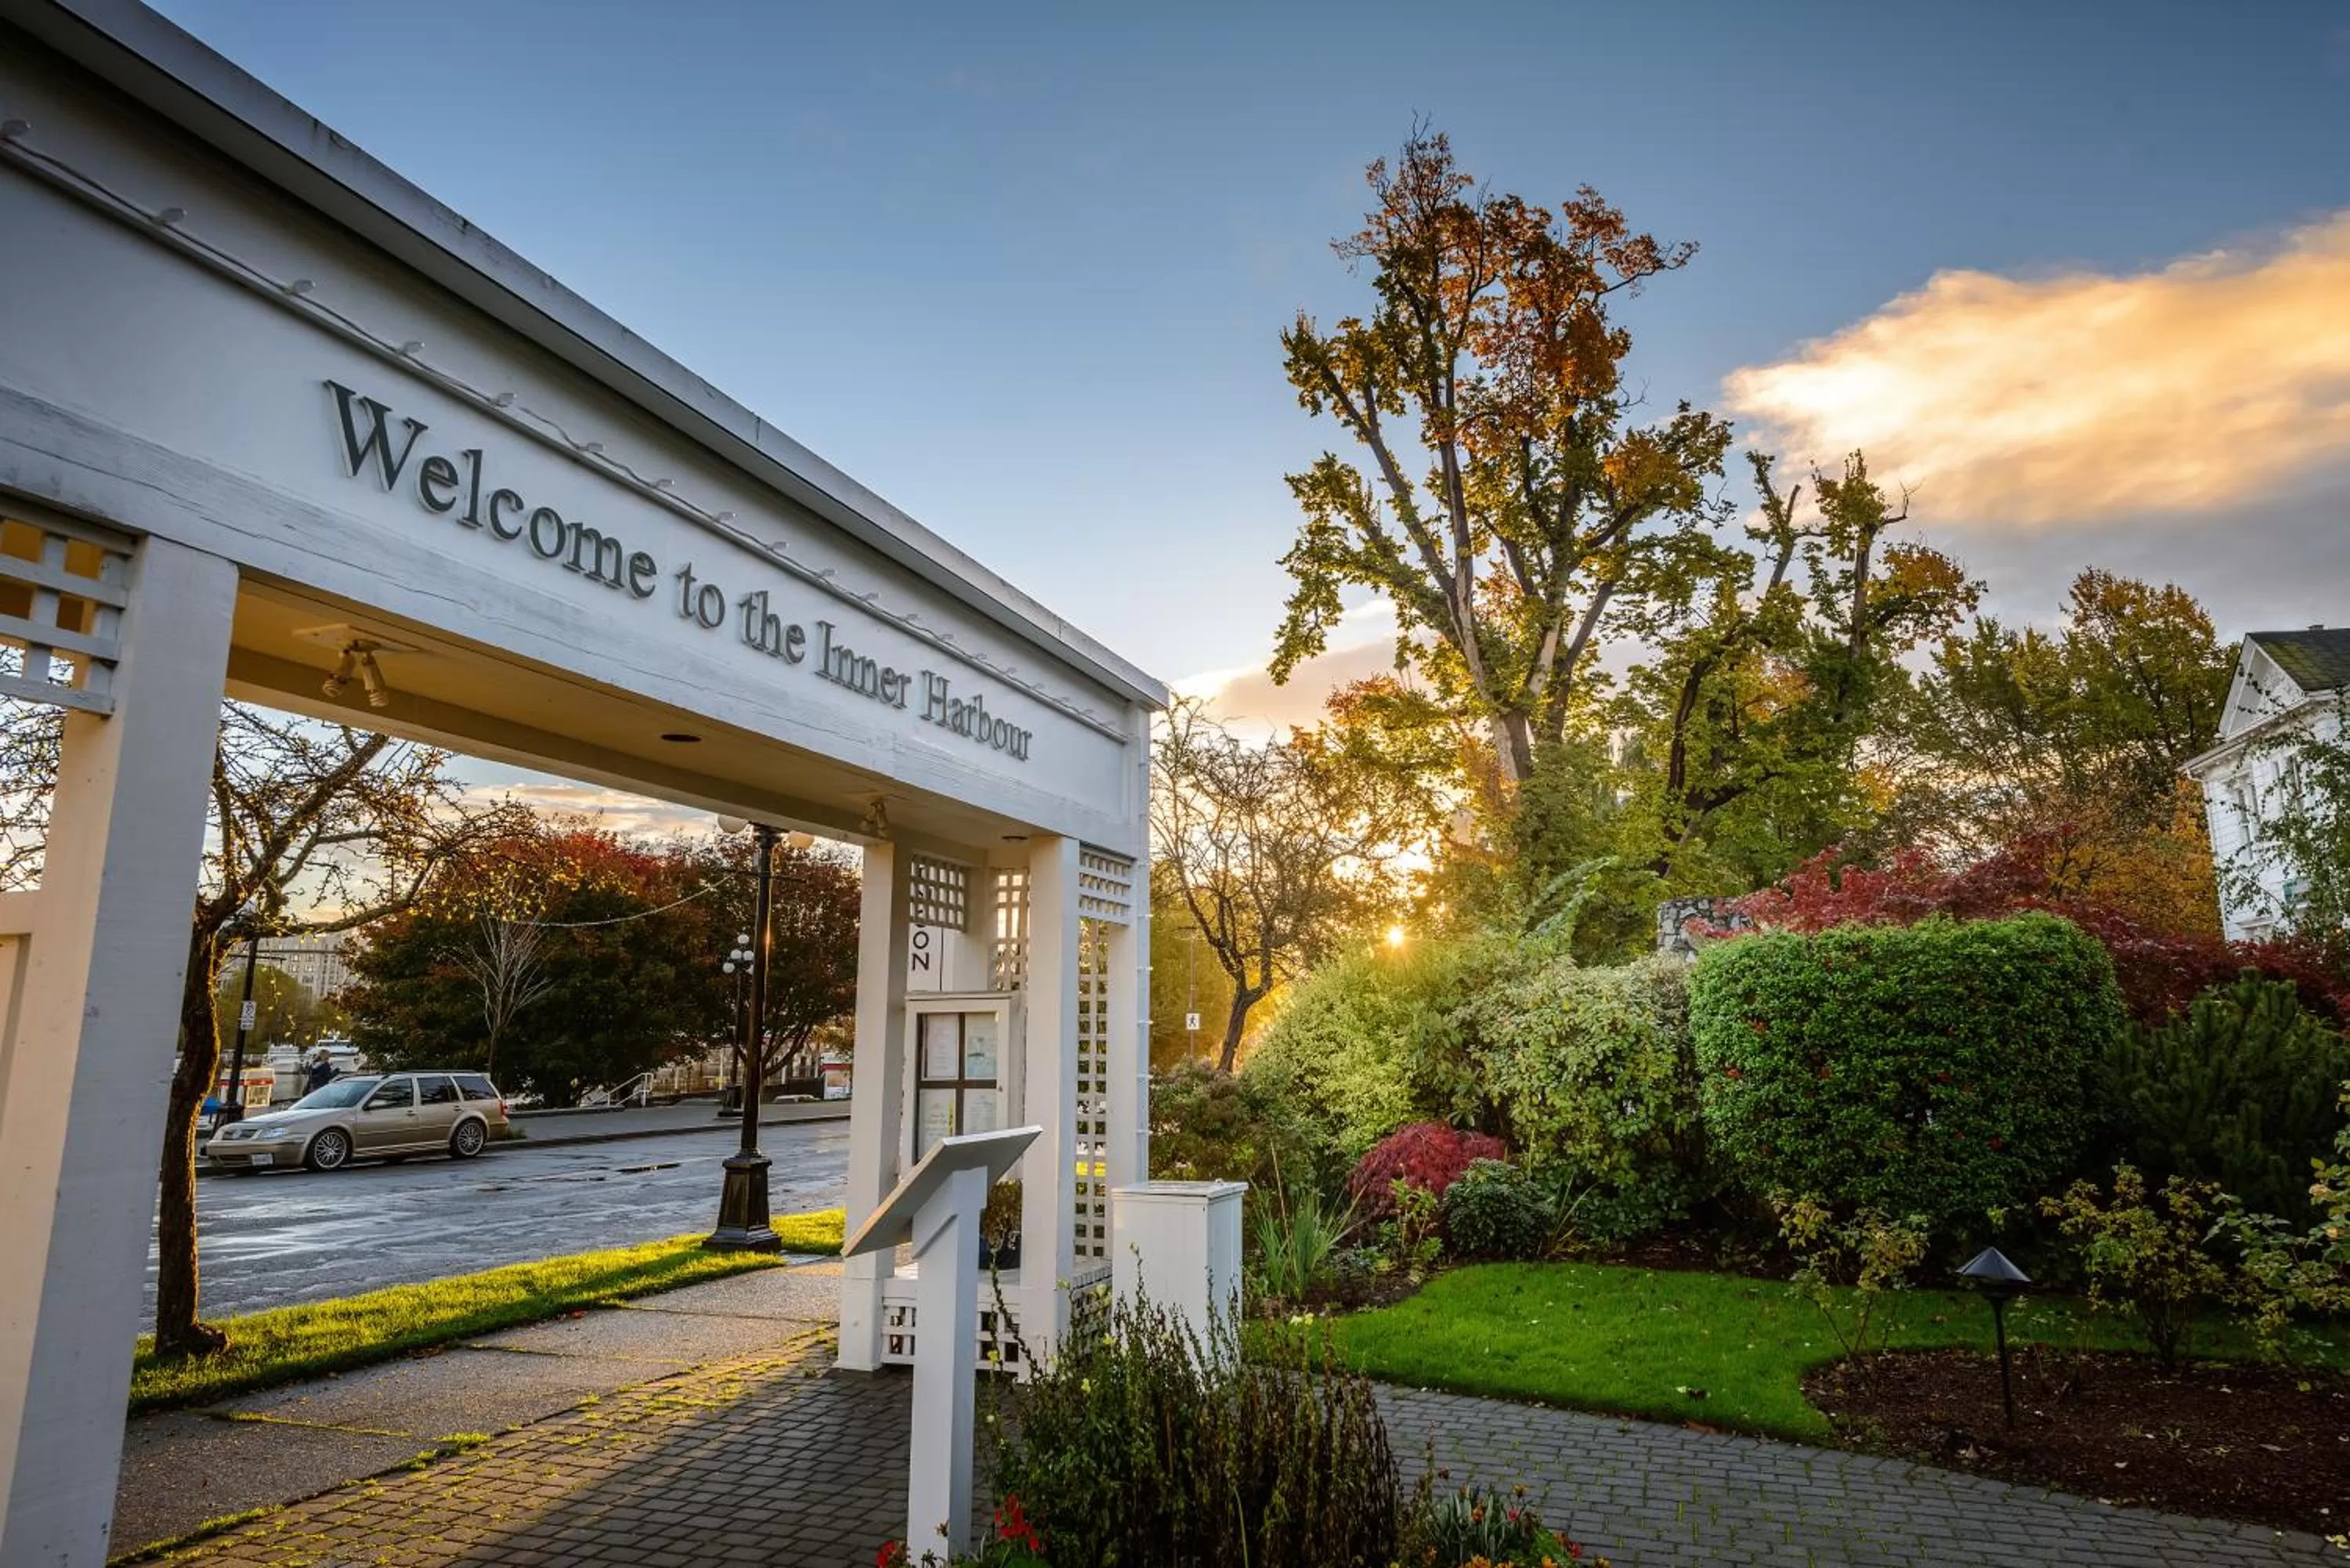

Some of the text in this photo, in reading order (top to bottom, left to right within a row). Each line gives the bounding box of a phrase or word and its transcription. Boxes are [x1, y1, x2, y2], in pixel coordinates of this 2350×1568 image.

[323, 379, 1032, 761] Welcome to the Inner Harbour
